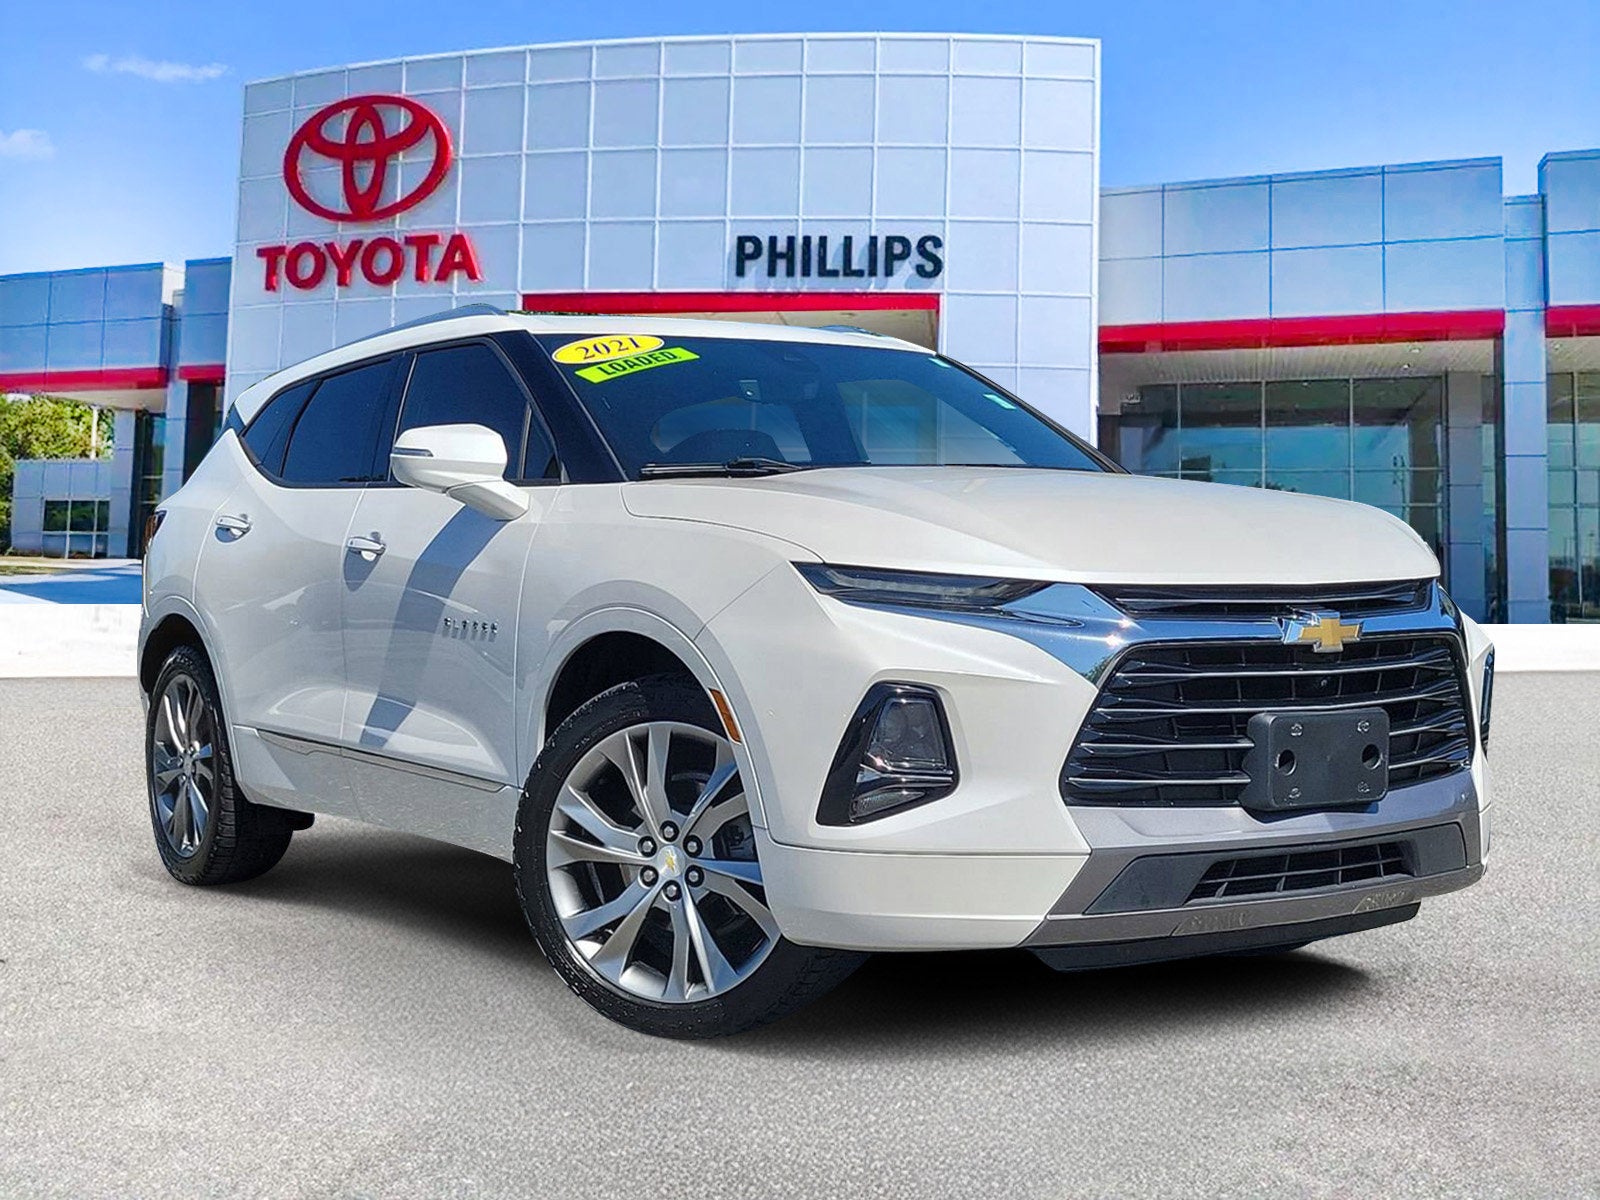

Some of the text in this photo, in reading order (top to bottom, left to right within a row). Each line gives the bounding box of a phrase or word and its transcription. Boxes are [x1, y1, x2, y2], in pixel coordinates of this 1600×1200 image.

[256, 233, 482, 292] TOYOTA
[735, 234, 944, 279] PHILLIPS
[575, 337, 641, 360] 2021
[597, 351, 679, 376] LOADED
